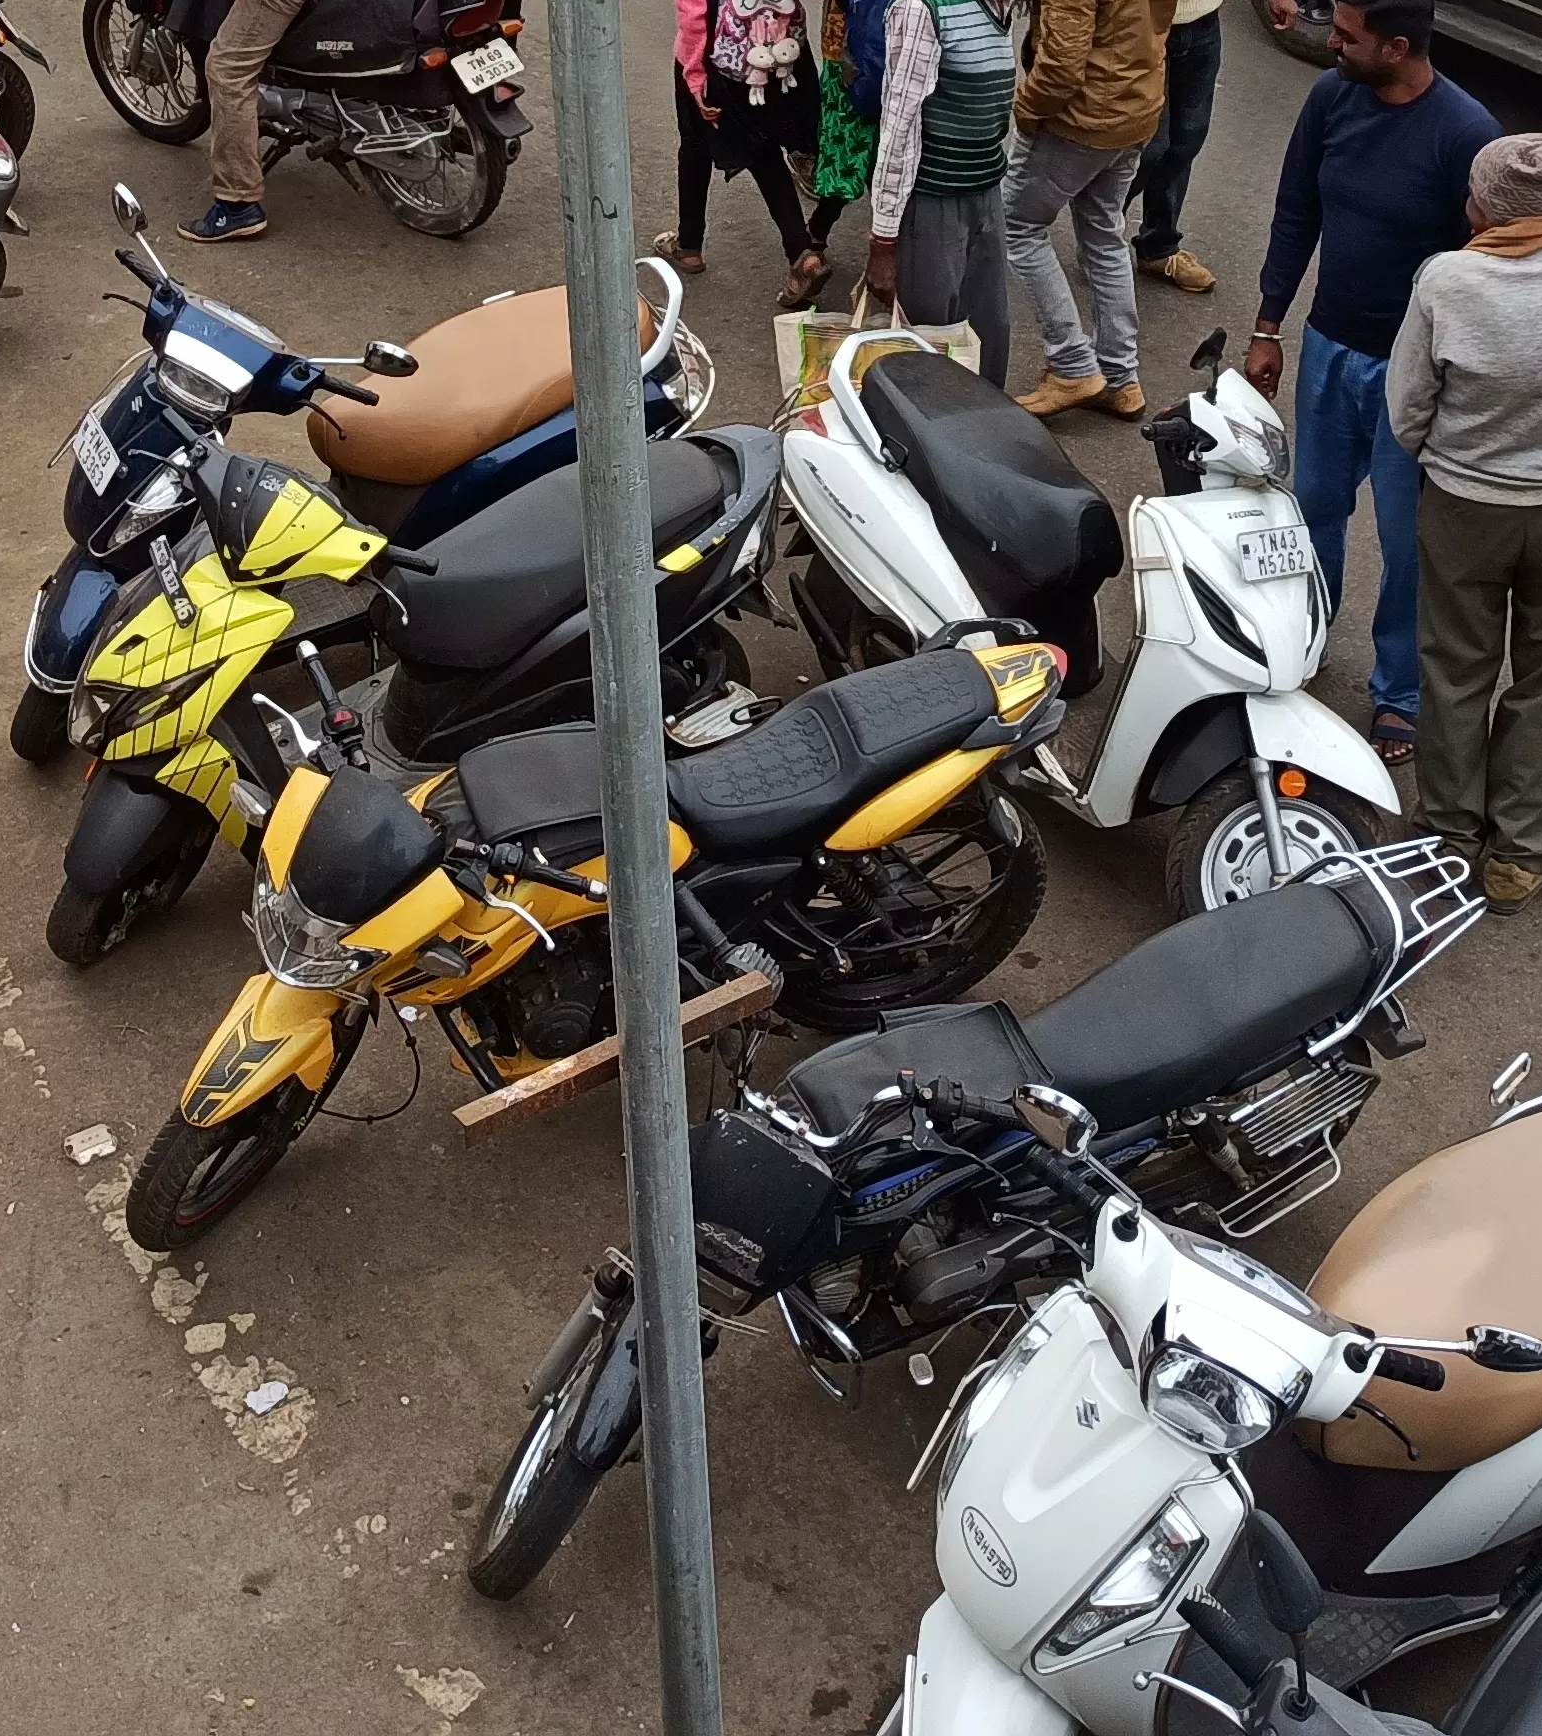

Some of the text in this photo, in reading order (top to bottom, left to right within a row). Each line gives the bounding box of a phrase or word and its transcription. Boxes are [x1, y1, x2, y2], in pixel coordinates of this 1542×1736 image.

[467, 49, 503, 71] TN 69
[471, 60, 516, 86] W 3033
[1227, 509, 1265, 520] HONDA
[1257, 529, 1299, 552] TN43
